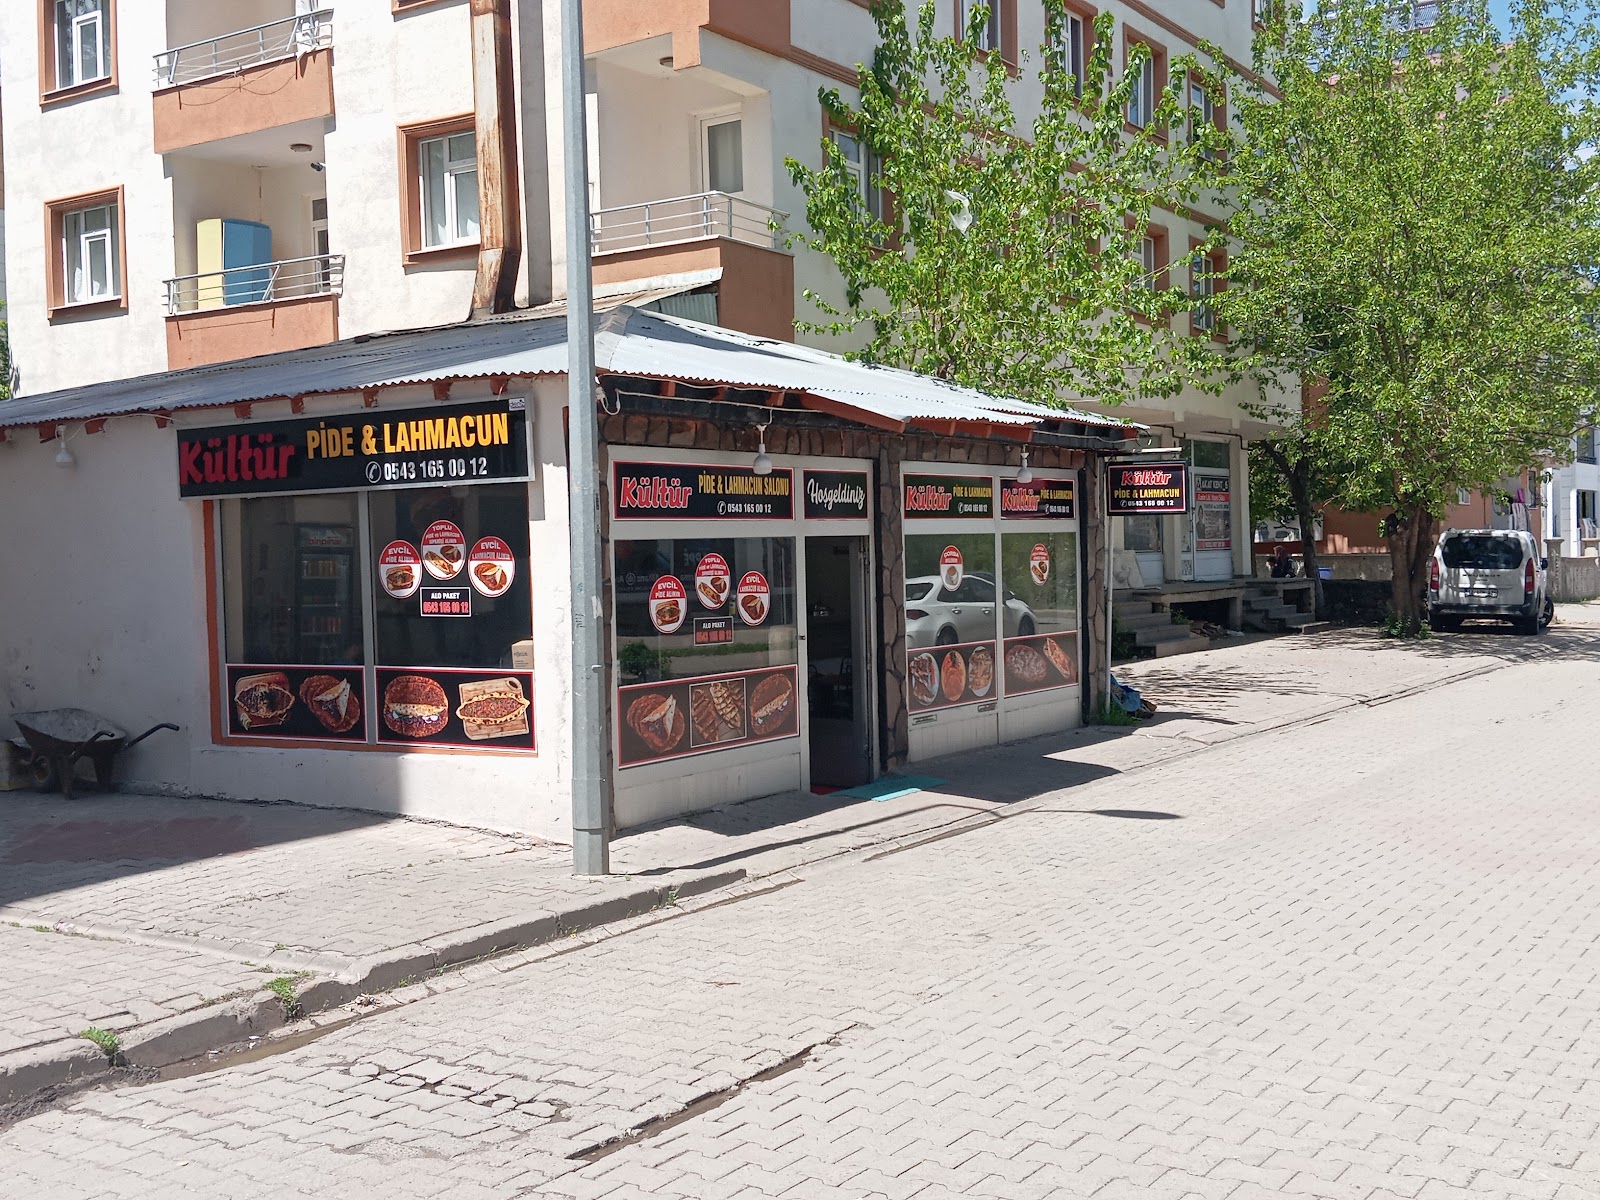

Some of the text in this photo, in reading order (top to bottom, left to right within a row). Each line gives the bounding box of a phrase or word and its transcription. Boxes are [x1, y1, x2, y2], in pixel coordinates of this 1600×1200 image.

[306, 412, 509, 460] PİDE & LAHMACUN
[179, 432, 295, 486] Kültür
[384, 457, 488, 481] 0543 165 00 12
[698, 470, 789, 497] PİDE & LAHMACUN SALONU
[1121, 470, 1172, 486] Kültür
[620, 475, 692, 509] Kültür
[806, 478, 866, 511] Hoşgeldiniz
[906, 484, 952, 511] Kültür
[953, 483, 992, 498] PİDE & LAHMACUN
[1040, 486, 1049, 500] PİDE
[1114, 487, 1180, 499] PİDE & LAHMACUN
[1002, 488, 1040, 512] Kültür
[727, 503, 772, 513] 0543 165 00 12
[388, 546, 411, 555] EVCİL
[481, 540, 501, 550] EVCİL
[658, 581, 678, 590] EVCİL
[746, 575, 760, 584] EVCİL
[461, 602, 469, 613] 12
